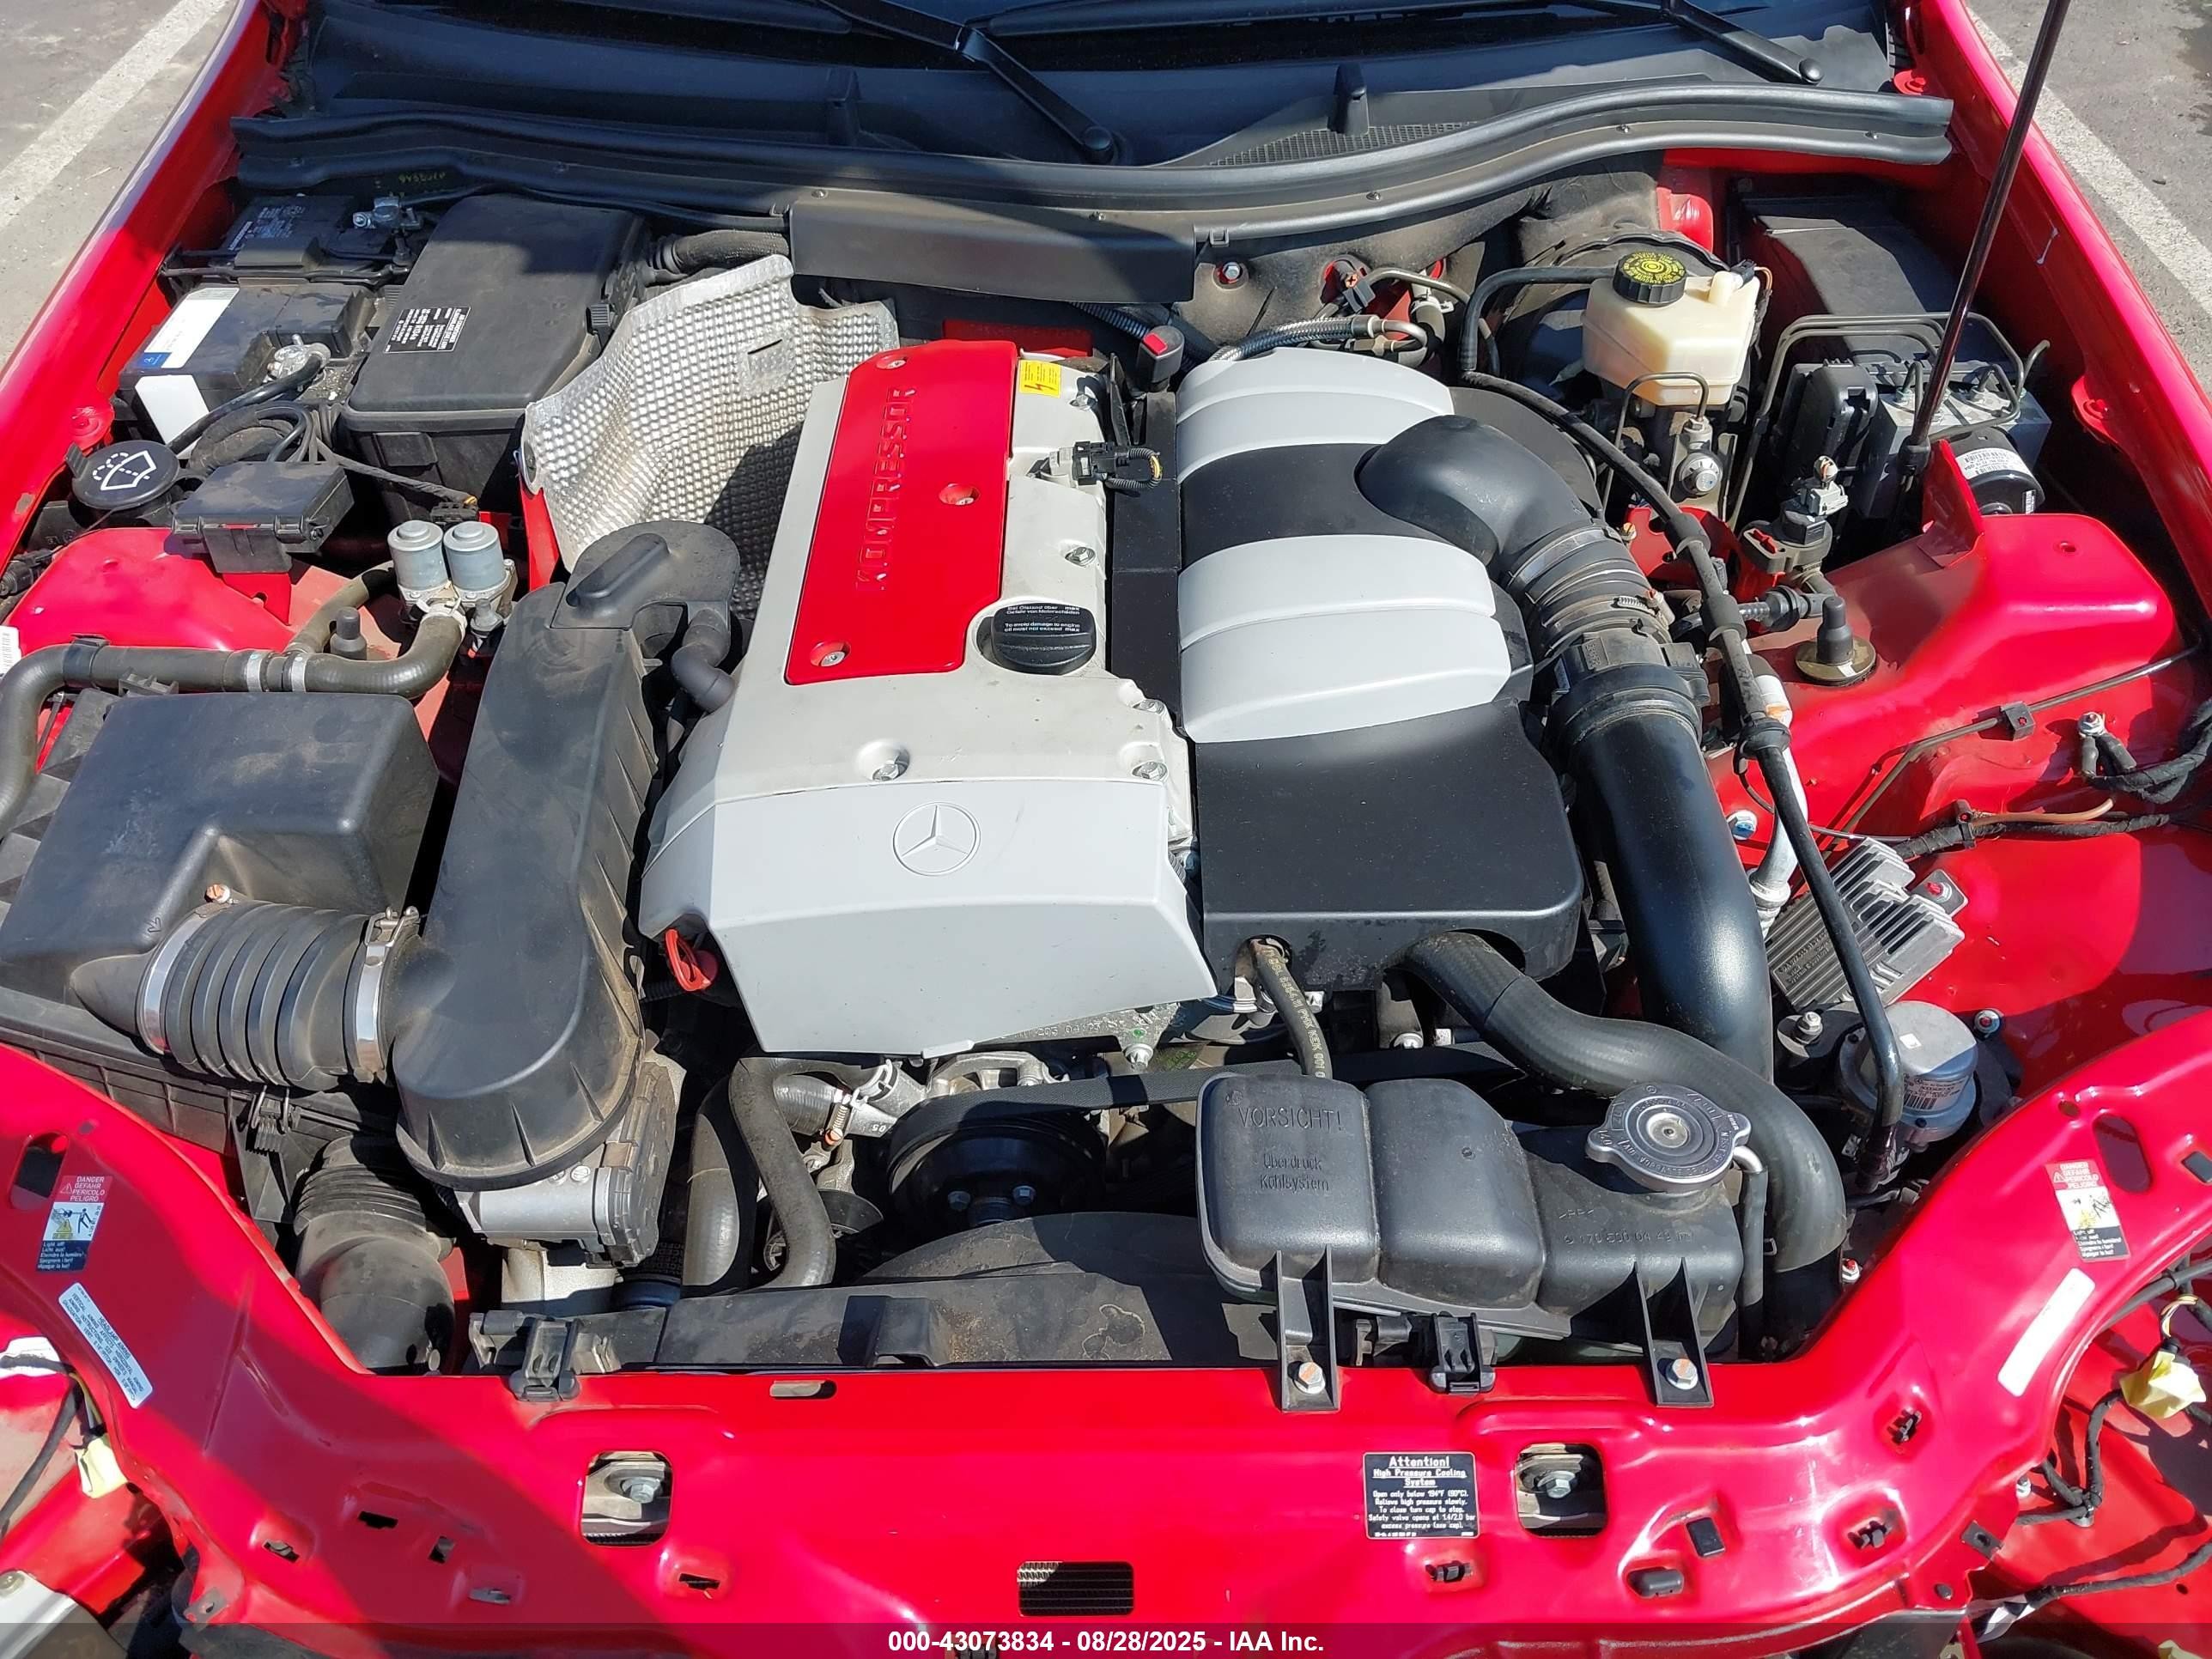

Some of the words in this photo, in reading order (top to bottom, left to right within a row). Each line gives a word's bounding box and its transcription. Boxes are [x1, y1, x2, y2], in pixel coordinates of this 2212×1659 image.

[855, 386, 917, 592] KOMPRESSOR
[1238, 1106, 1342, 1132] VORSICHT!
[86, 1313, 100, 1328] AIMING
[97, 1316, 118, 1342] HEADLAMP
[115, 1340, 131, 1359] AIMING
[1389, 1455, 1450, 1468] Attention!
[1404, 1478, 1436, 1486] System
